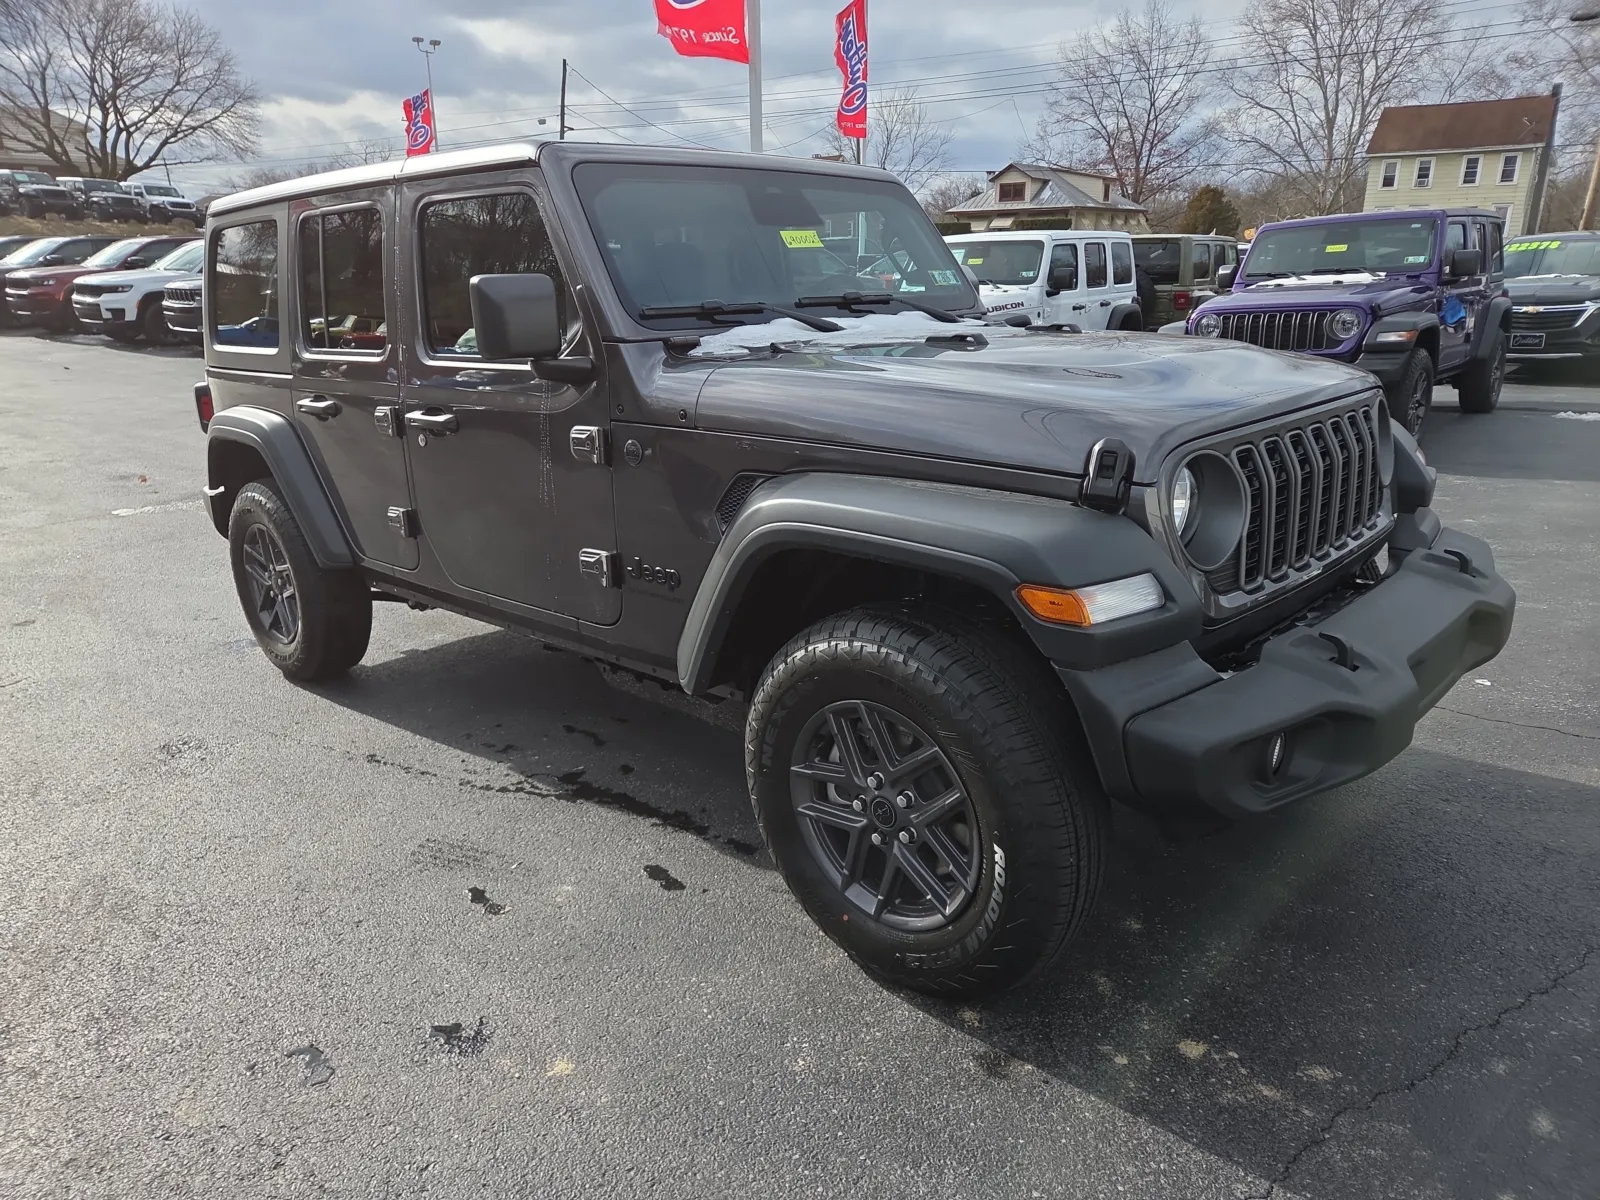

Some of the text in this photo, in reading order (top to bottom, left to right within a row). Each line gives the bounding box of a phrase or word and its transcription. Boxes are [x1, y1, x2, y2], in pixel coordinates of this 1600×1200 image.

[986, 301, 1025, 314] UBICON
[626, 556, 682, 592] Jeep
[761, 679, 815, 768] NEXEN
[966, 841, 1008, 956] ROADIAN
